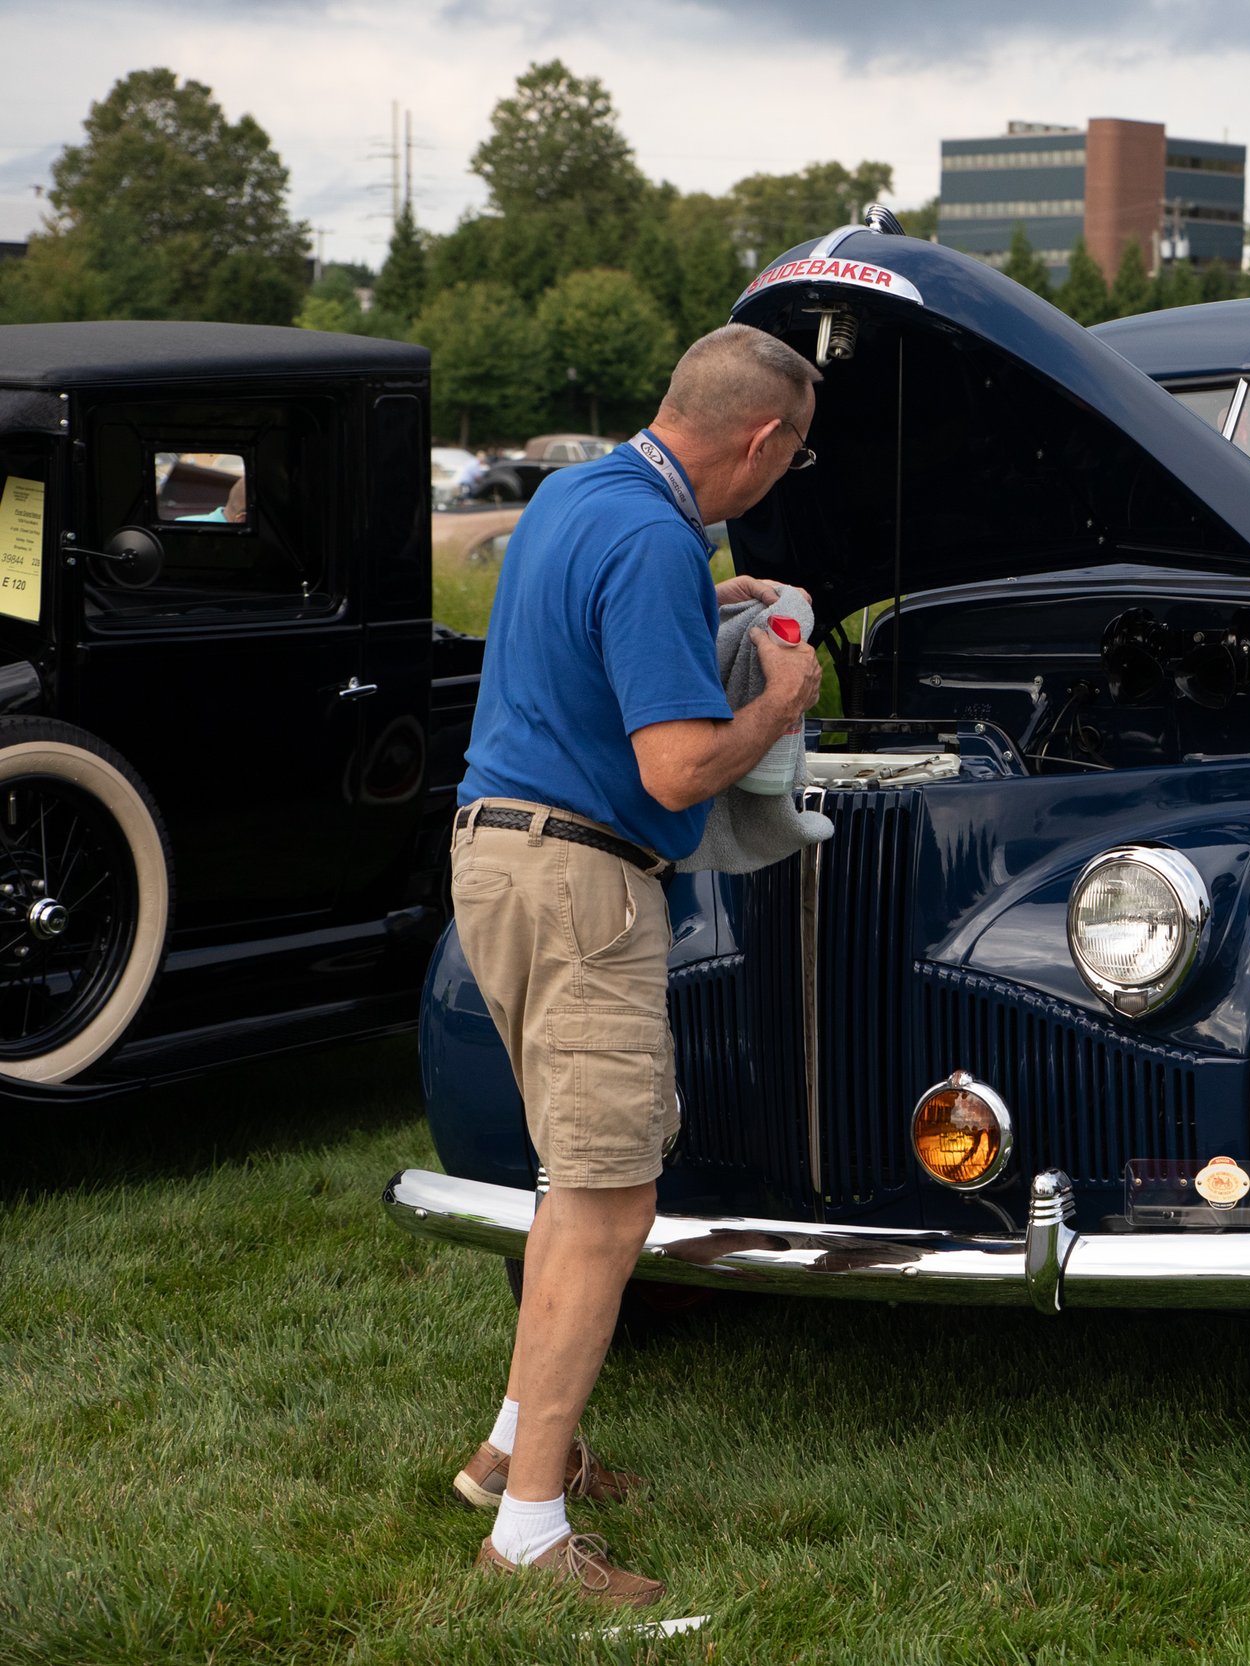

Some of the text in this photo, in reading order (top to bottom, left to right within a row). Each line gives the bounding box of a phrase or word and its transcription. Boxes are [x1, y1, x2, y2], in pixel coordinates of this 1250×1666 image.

[747, 260, 893, 294] STUDEBAKER
[665, 472, 687, 503] Auctions
[2, 576, 26, 591] E 120
